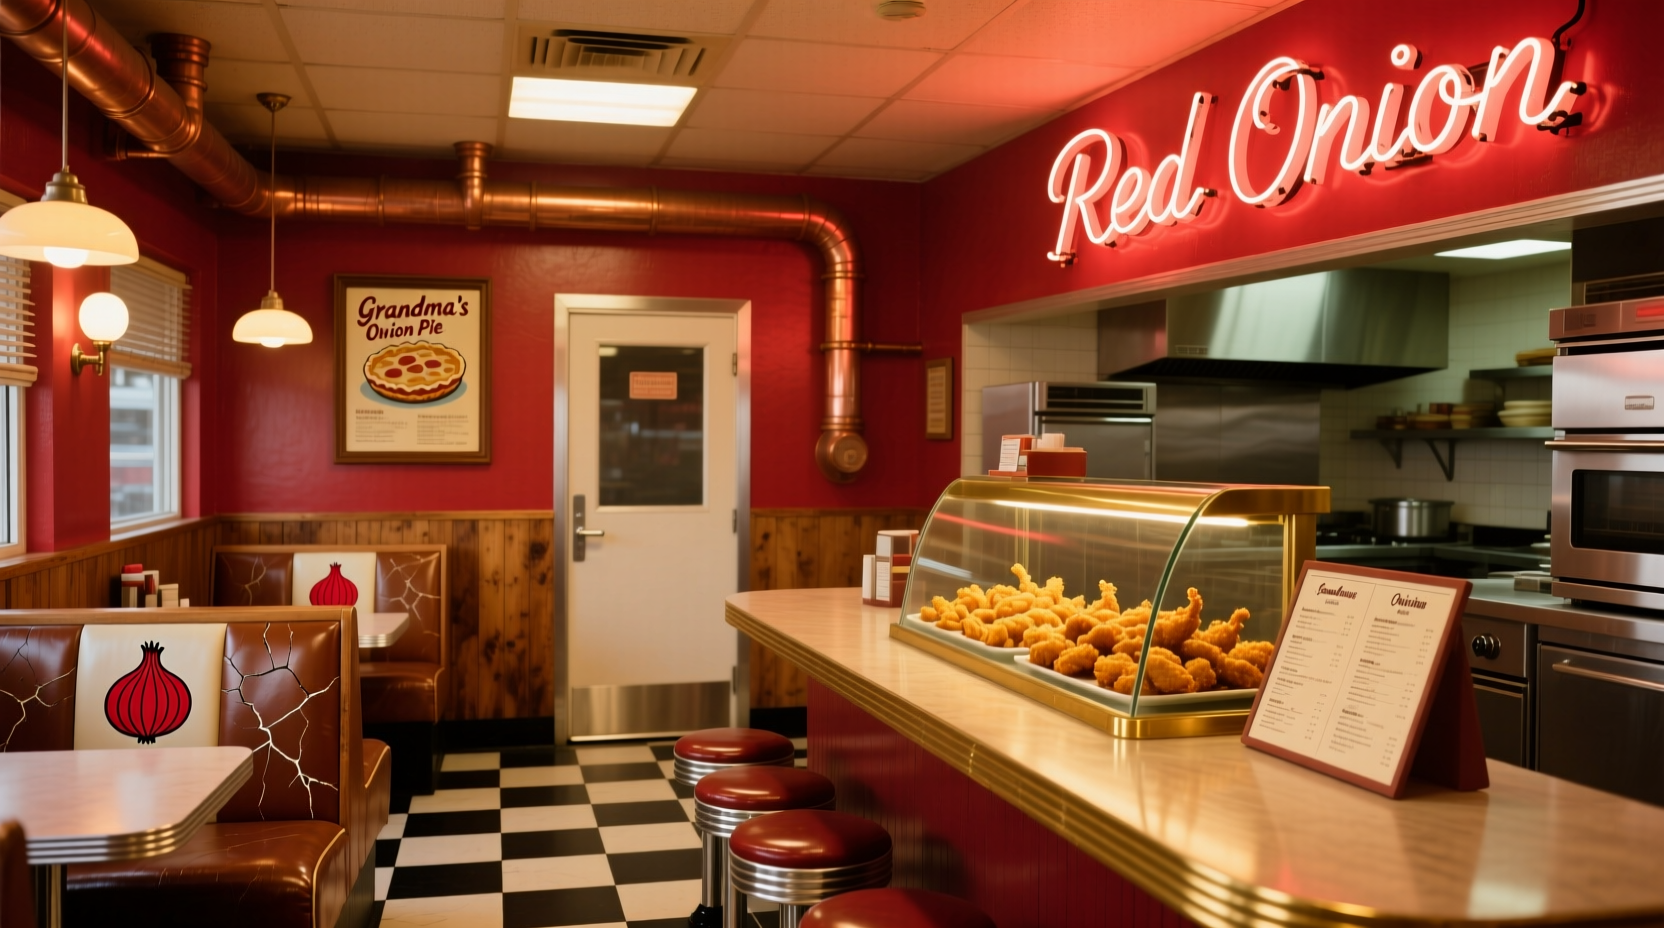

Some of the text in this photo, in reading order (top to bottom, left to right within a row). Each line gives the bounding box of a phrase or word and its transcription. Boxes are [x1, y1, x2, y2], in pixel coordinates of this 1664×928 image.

[1047, 37, 1585, 262] Red Onion
[357, 295, 469, 327] Grandma's
[366, 319, 443, 341] Onion Pie
